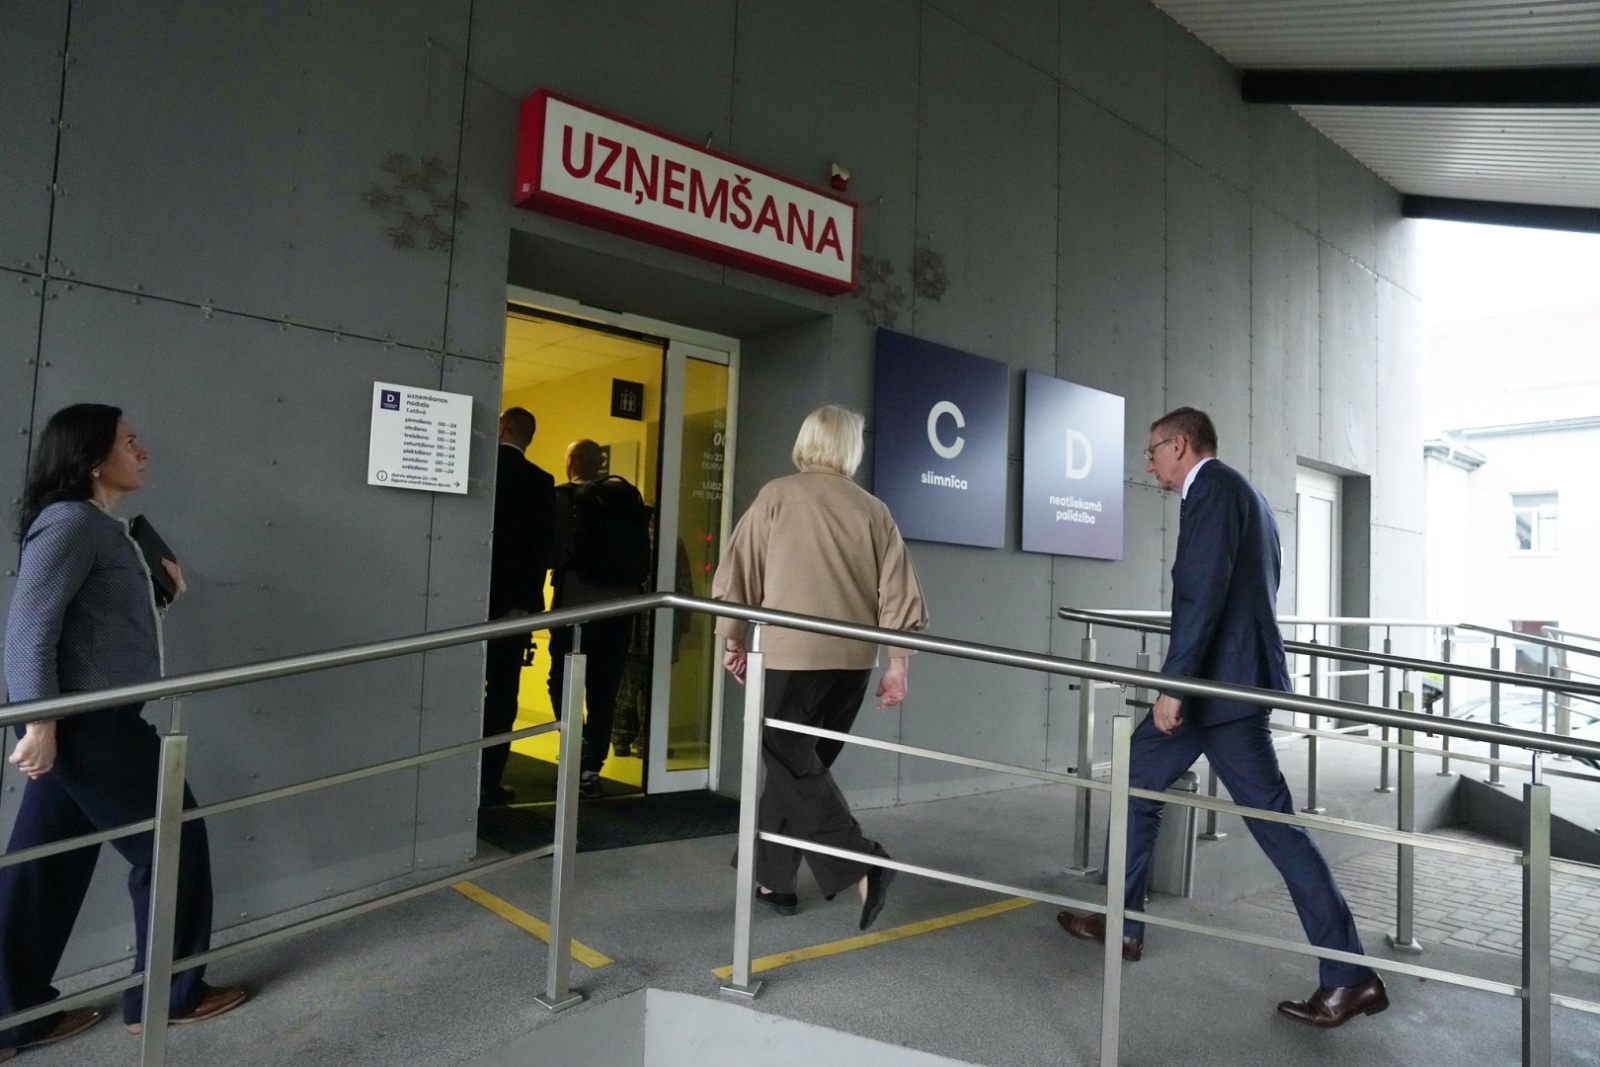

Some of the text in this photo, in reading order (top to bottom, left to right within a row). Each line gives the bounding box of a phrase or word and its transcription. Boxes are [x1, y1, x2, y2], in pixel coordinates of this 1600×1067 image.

[562, 124, 844, 262] UZŅEMŠANA
[387, 394, 394, 402] D
[407, 393, 448, 403] uzņemšanas
[405, 417, 432, 425] pirmdiena
[927, 400, 966, 459] C
[1066, 428, 1092, 480] D
[702, 481, 723, 491] LŪDZ
[921, 470, 968, 490] slimnīca
[1050, 496, 1102, 512] neatliekamā
[1056, 510, 1096, 524] palīdzība
